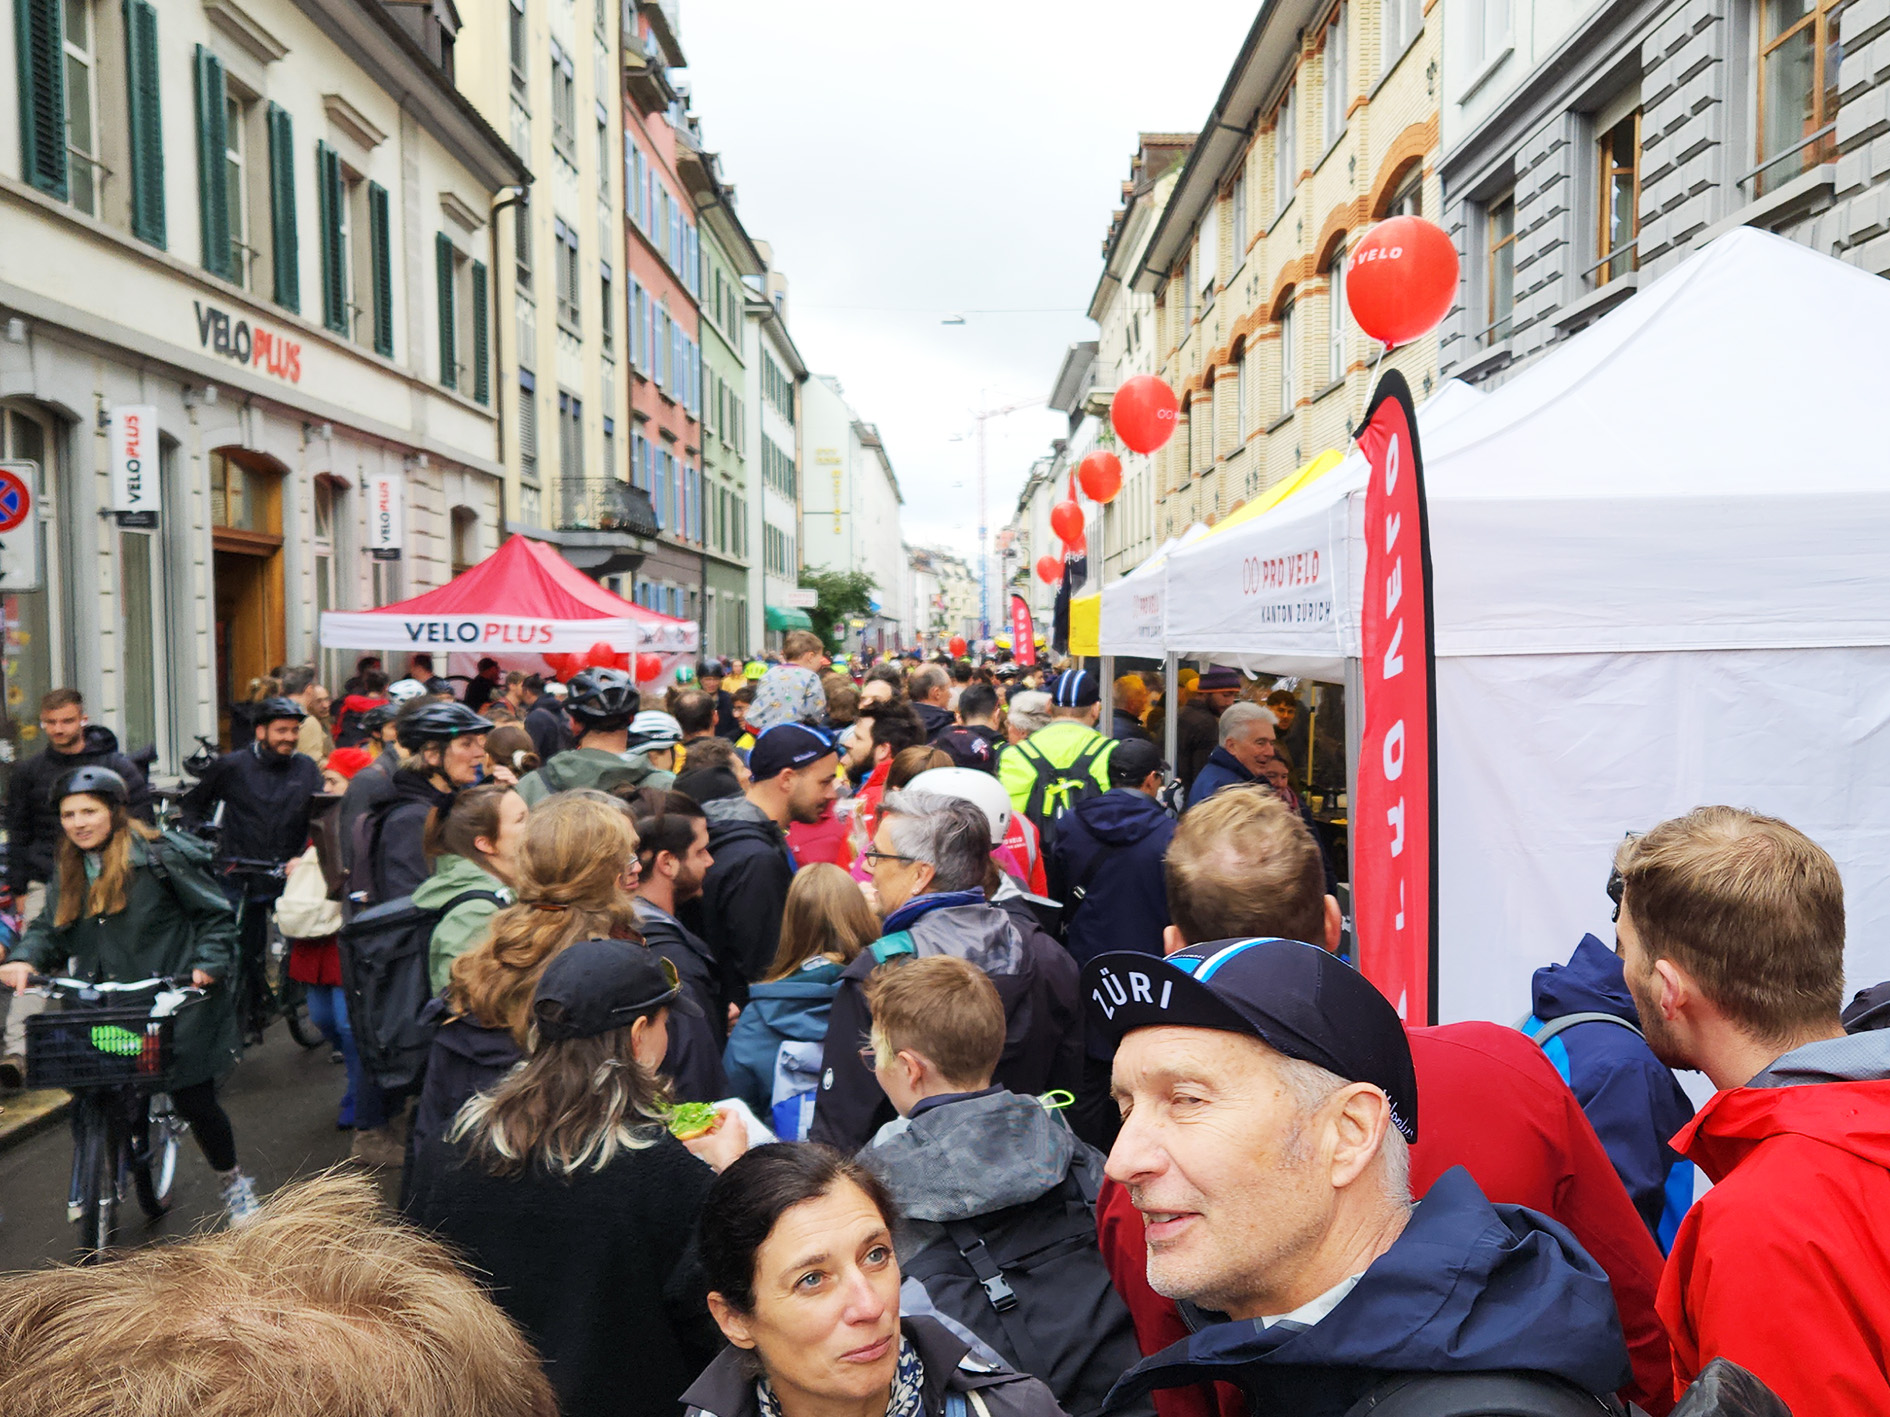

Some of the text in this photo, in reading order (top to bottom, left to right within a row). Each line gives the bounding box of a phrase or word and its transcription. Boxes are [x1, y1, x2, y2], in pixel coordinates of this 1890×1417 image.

[1358, 246, 1403, 265] VELO
[194, 300, 301, 384] VELOPLUS
[125, 414, 142, 504] VELOPLUS
[1262, 550, 1320, 590] PRO VELO
[1261, 599, 1331, 624] KANTON ZÜRICH
[405, 621, 554, 644] VELOPLUS
[1092, 967, 1172, 1021] ZÜRI
